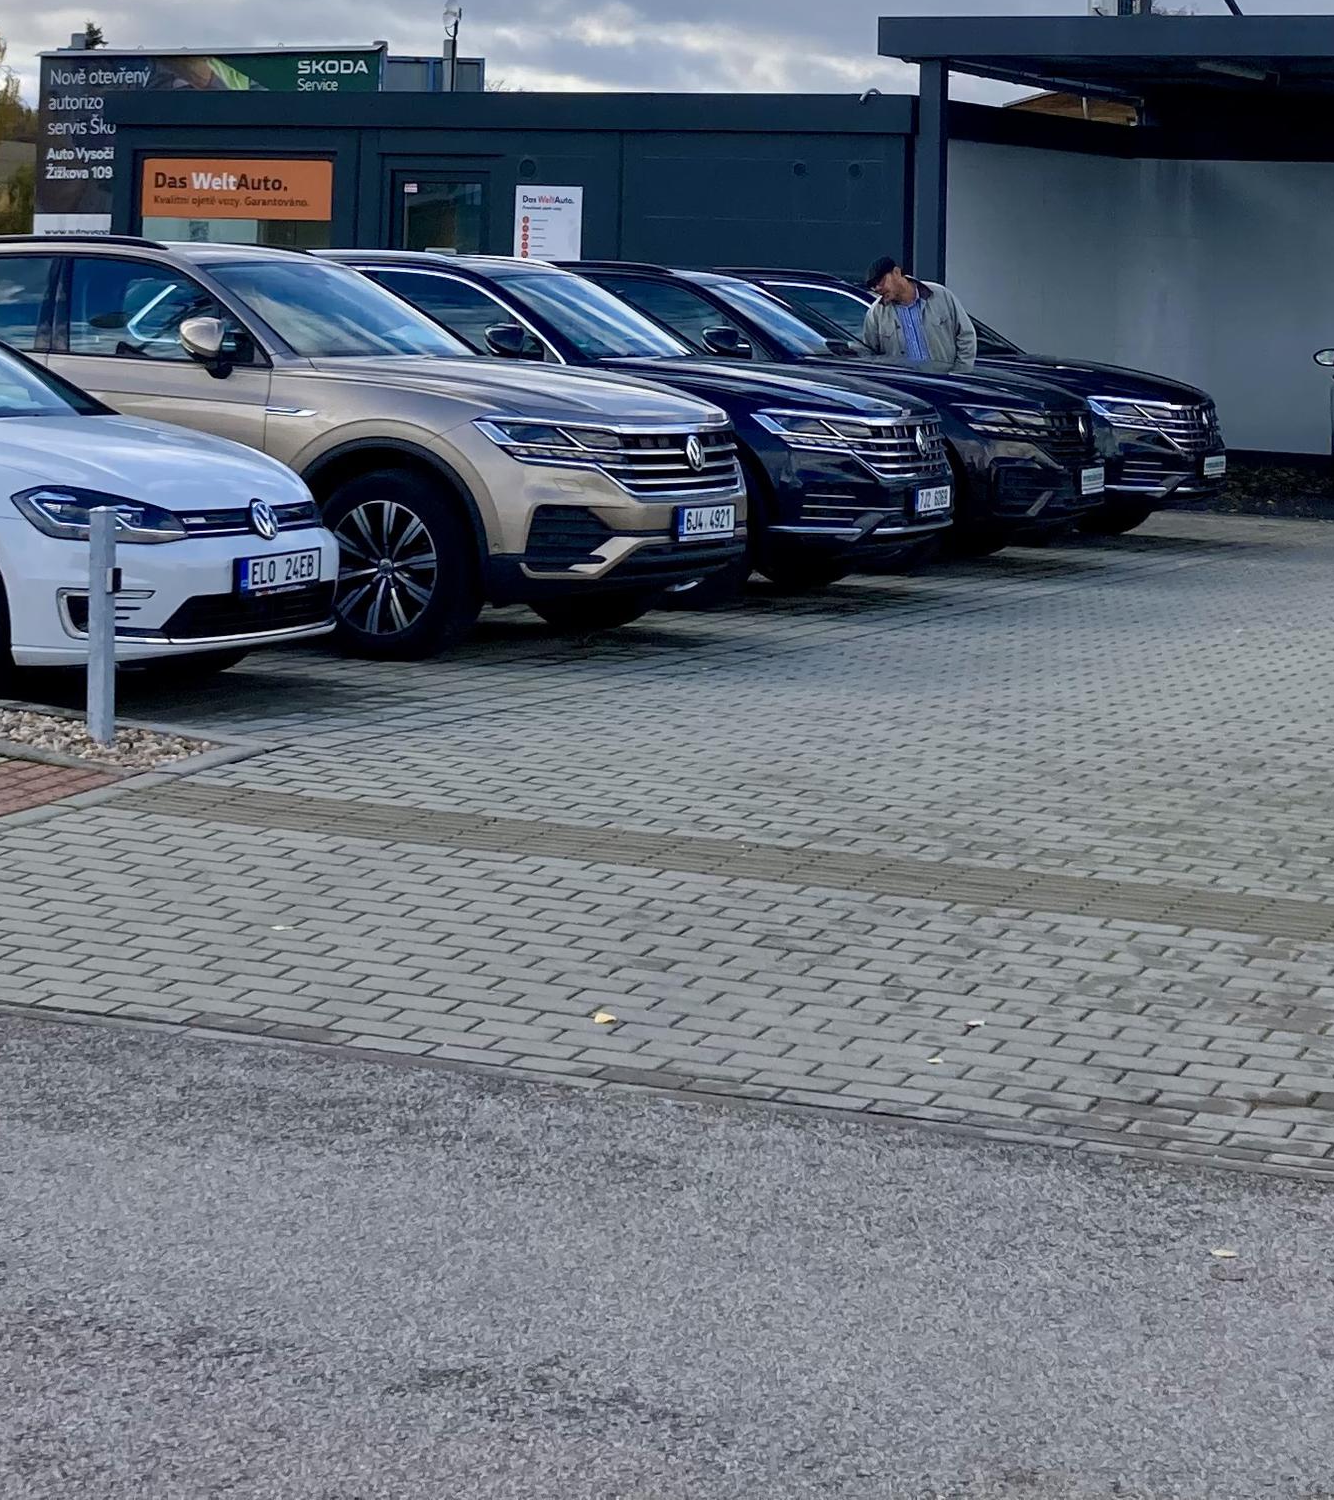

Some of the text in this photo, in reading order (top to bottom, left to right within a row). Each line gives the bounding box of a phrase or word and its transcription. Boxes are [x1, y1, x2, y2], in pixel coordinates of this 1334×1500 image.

[50, 66, 151, 88] Nově otevřený
[297, 78, 339, 91] Service
[47, 119, 87, 135] servis
[46, 148, 74, 160] Auto
[91, 166, 113, 178] 109
[154, 172, 288, 192] Das WeltAuto.
[710, 508, 730, 529] 4921
[285, 554, 314, 580] 24EB
